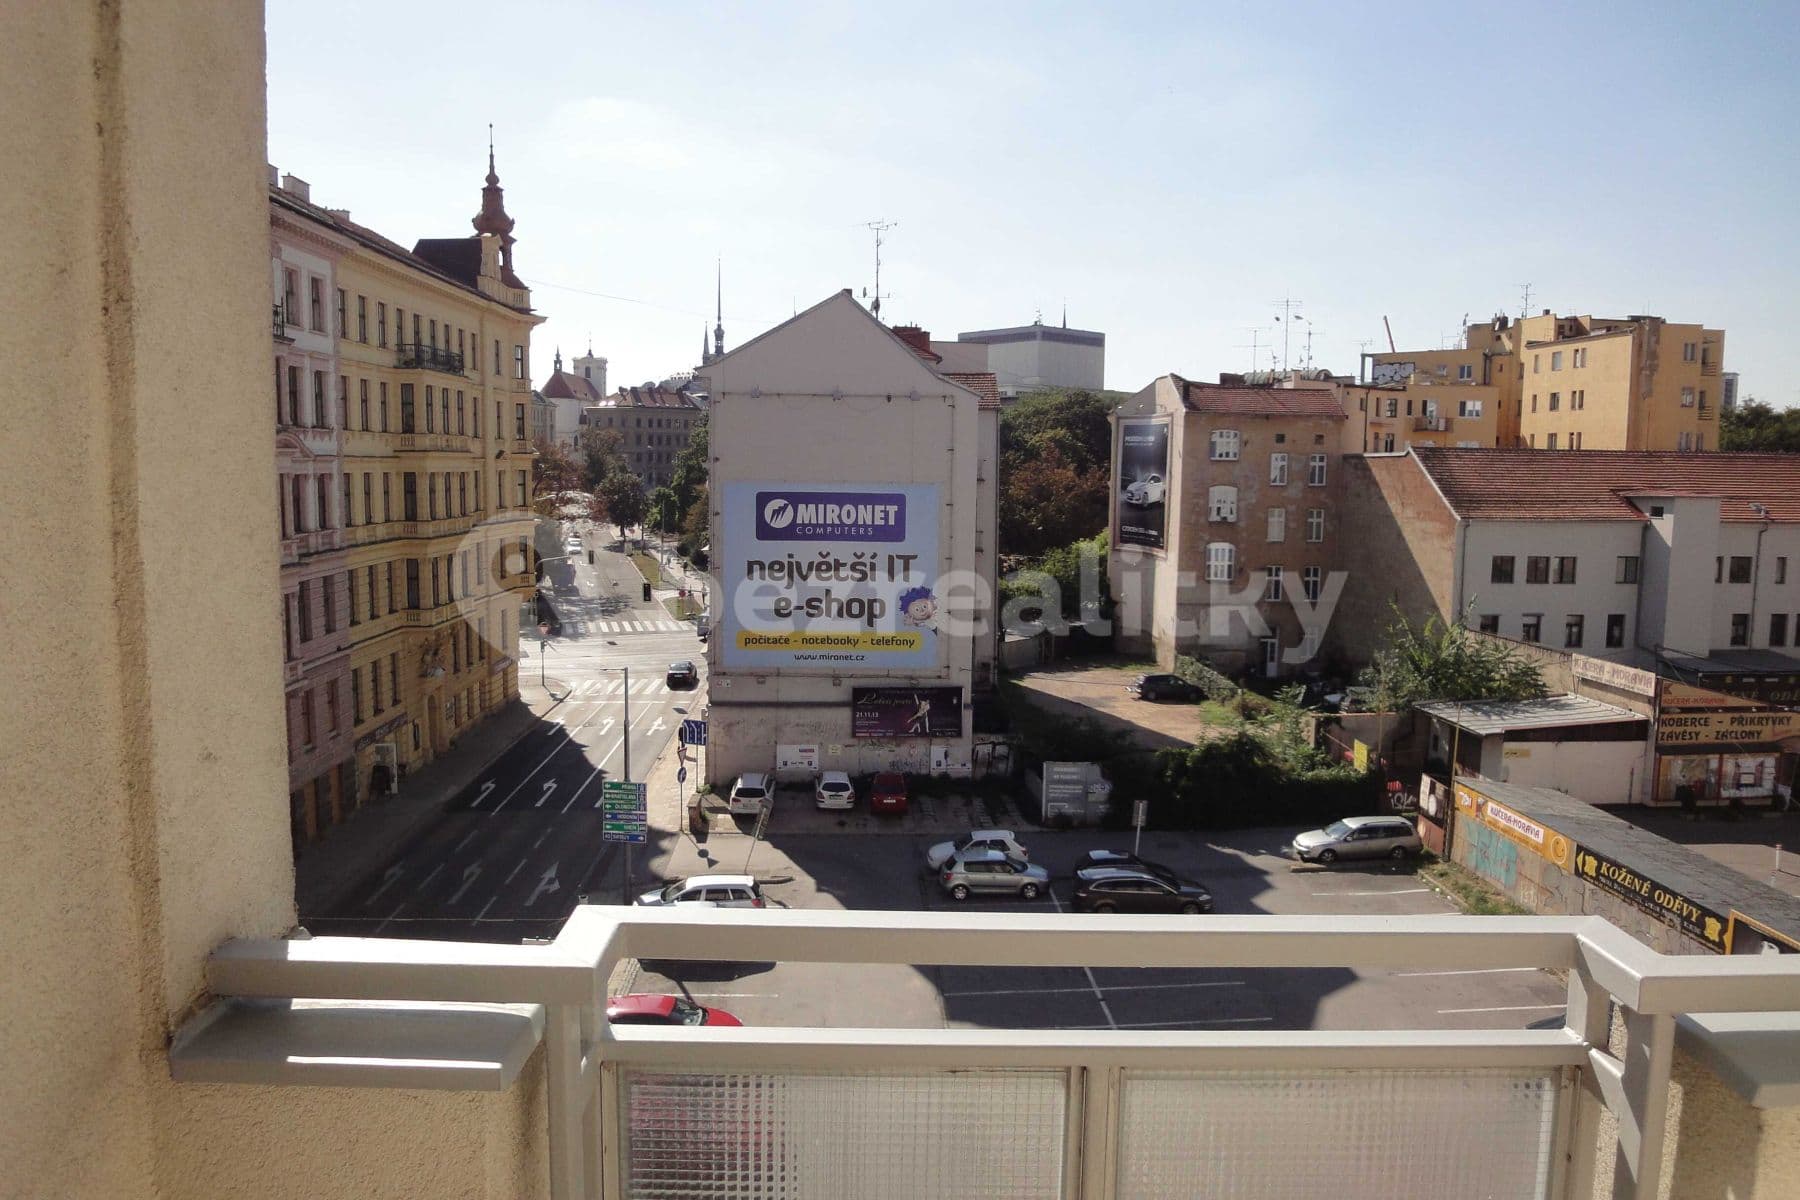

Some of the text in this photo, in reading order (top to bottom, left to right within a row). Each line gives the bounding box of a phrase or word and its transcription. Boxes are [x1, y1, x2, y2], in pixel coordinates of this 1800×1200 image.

[796, 503, 898, 526] MIRONET
[796, 526, 874, 536] COMPUTERS
[746, 551, 918, 590] největší IT
[773, 589, 886, 627] e-shop
[801, 635, 859, 648] notebooky
[870, 635, 915, 648] telefony
[794, 652, 865, 662] www.mironet.cz
[1661, 716, 1711, 728] KOBERCE
[1600, 861, 1651, 896] KOŽENÉ
[1654, 889, 1702, 923] ODĚVY
